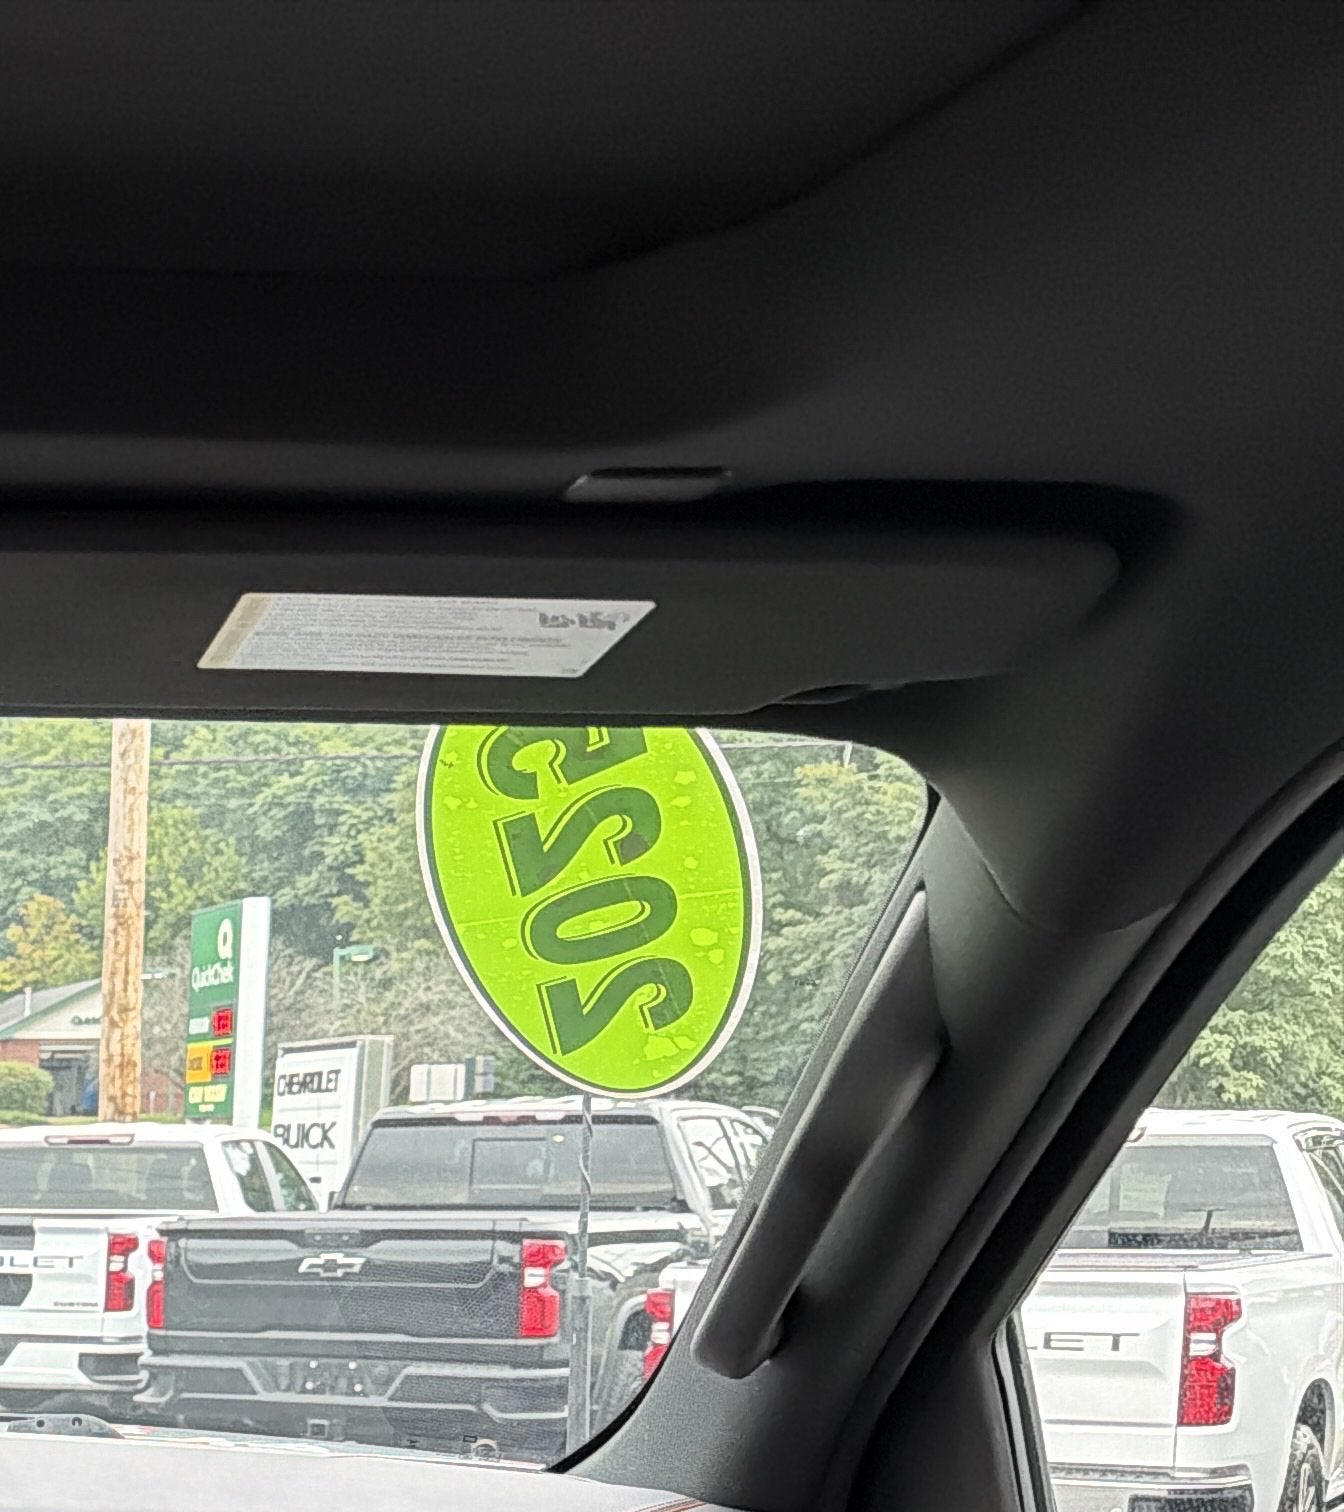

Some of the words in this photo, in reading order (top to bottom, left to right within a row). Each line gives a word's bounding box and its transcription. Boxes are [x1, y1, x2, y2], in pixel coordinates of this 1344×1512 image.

[217, 918, 233, 960] Q
[277, 1069, 342, 1097] CHEVROLET
[274, 1122, 337, 1150] BUICK
[1027, 1331, 1140, 1351] ET
